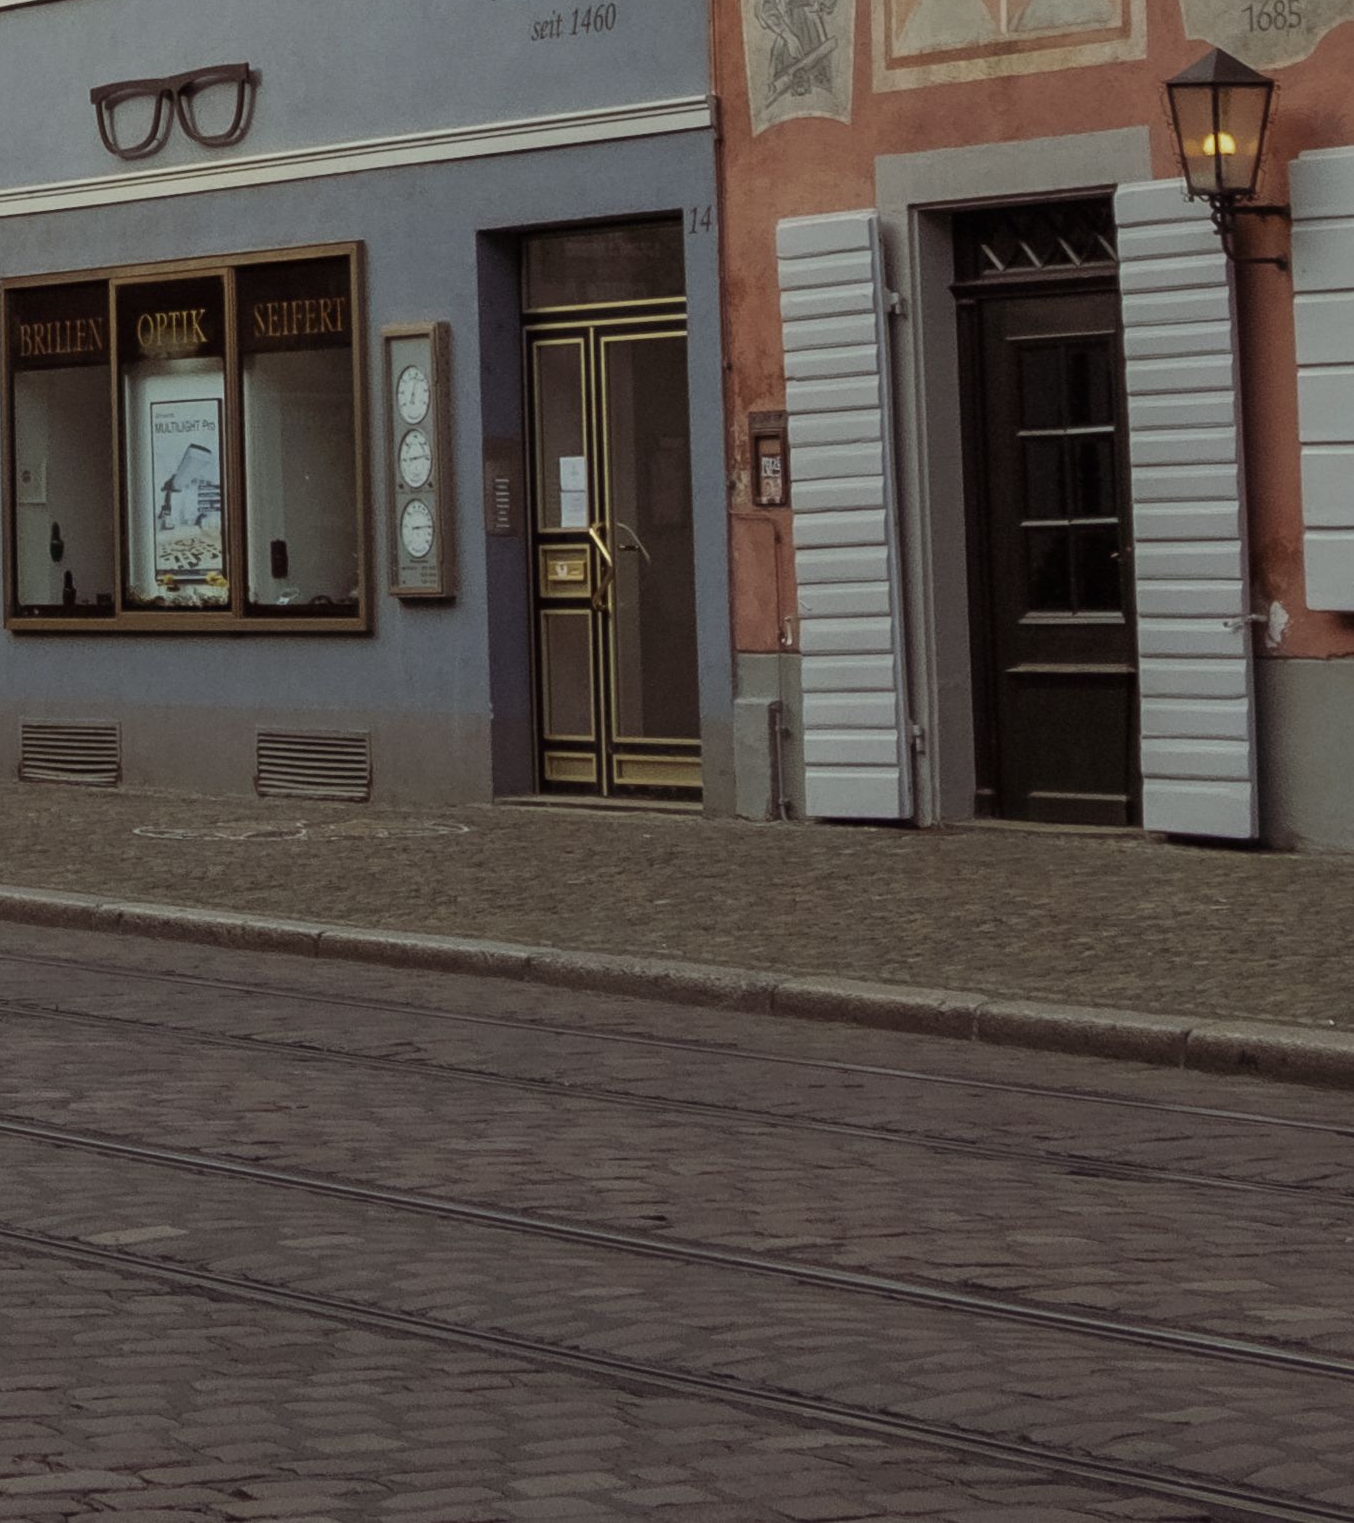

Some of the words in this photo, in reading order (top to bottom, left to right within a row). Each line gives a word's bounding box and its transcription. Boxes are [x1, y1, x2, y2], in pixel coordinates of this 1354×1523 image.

[531, 10, 563, 42] seit
[570, 2, 617, 36] 1460
[687, 205, 714, 235] 14
[18, 316, 105, 358] BRILLEN
[135, 308, 209, 348] OPTIK
[252, 296, 348, 338] SEIFERT
